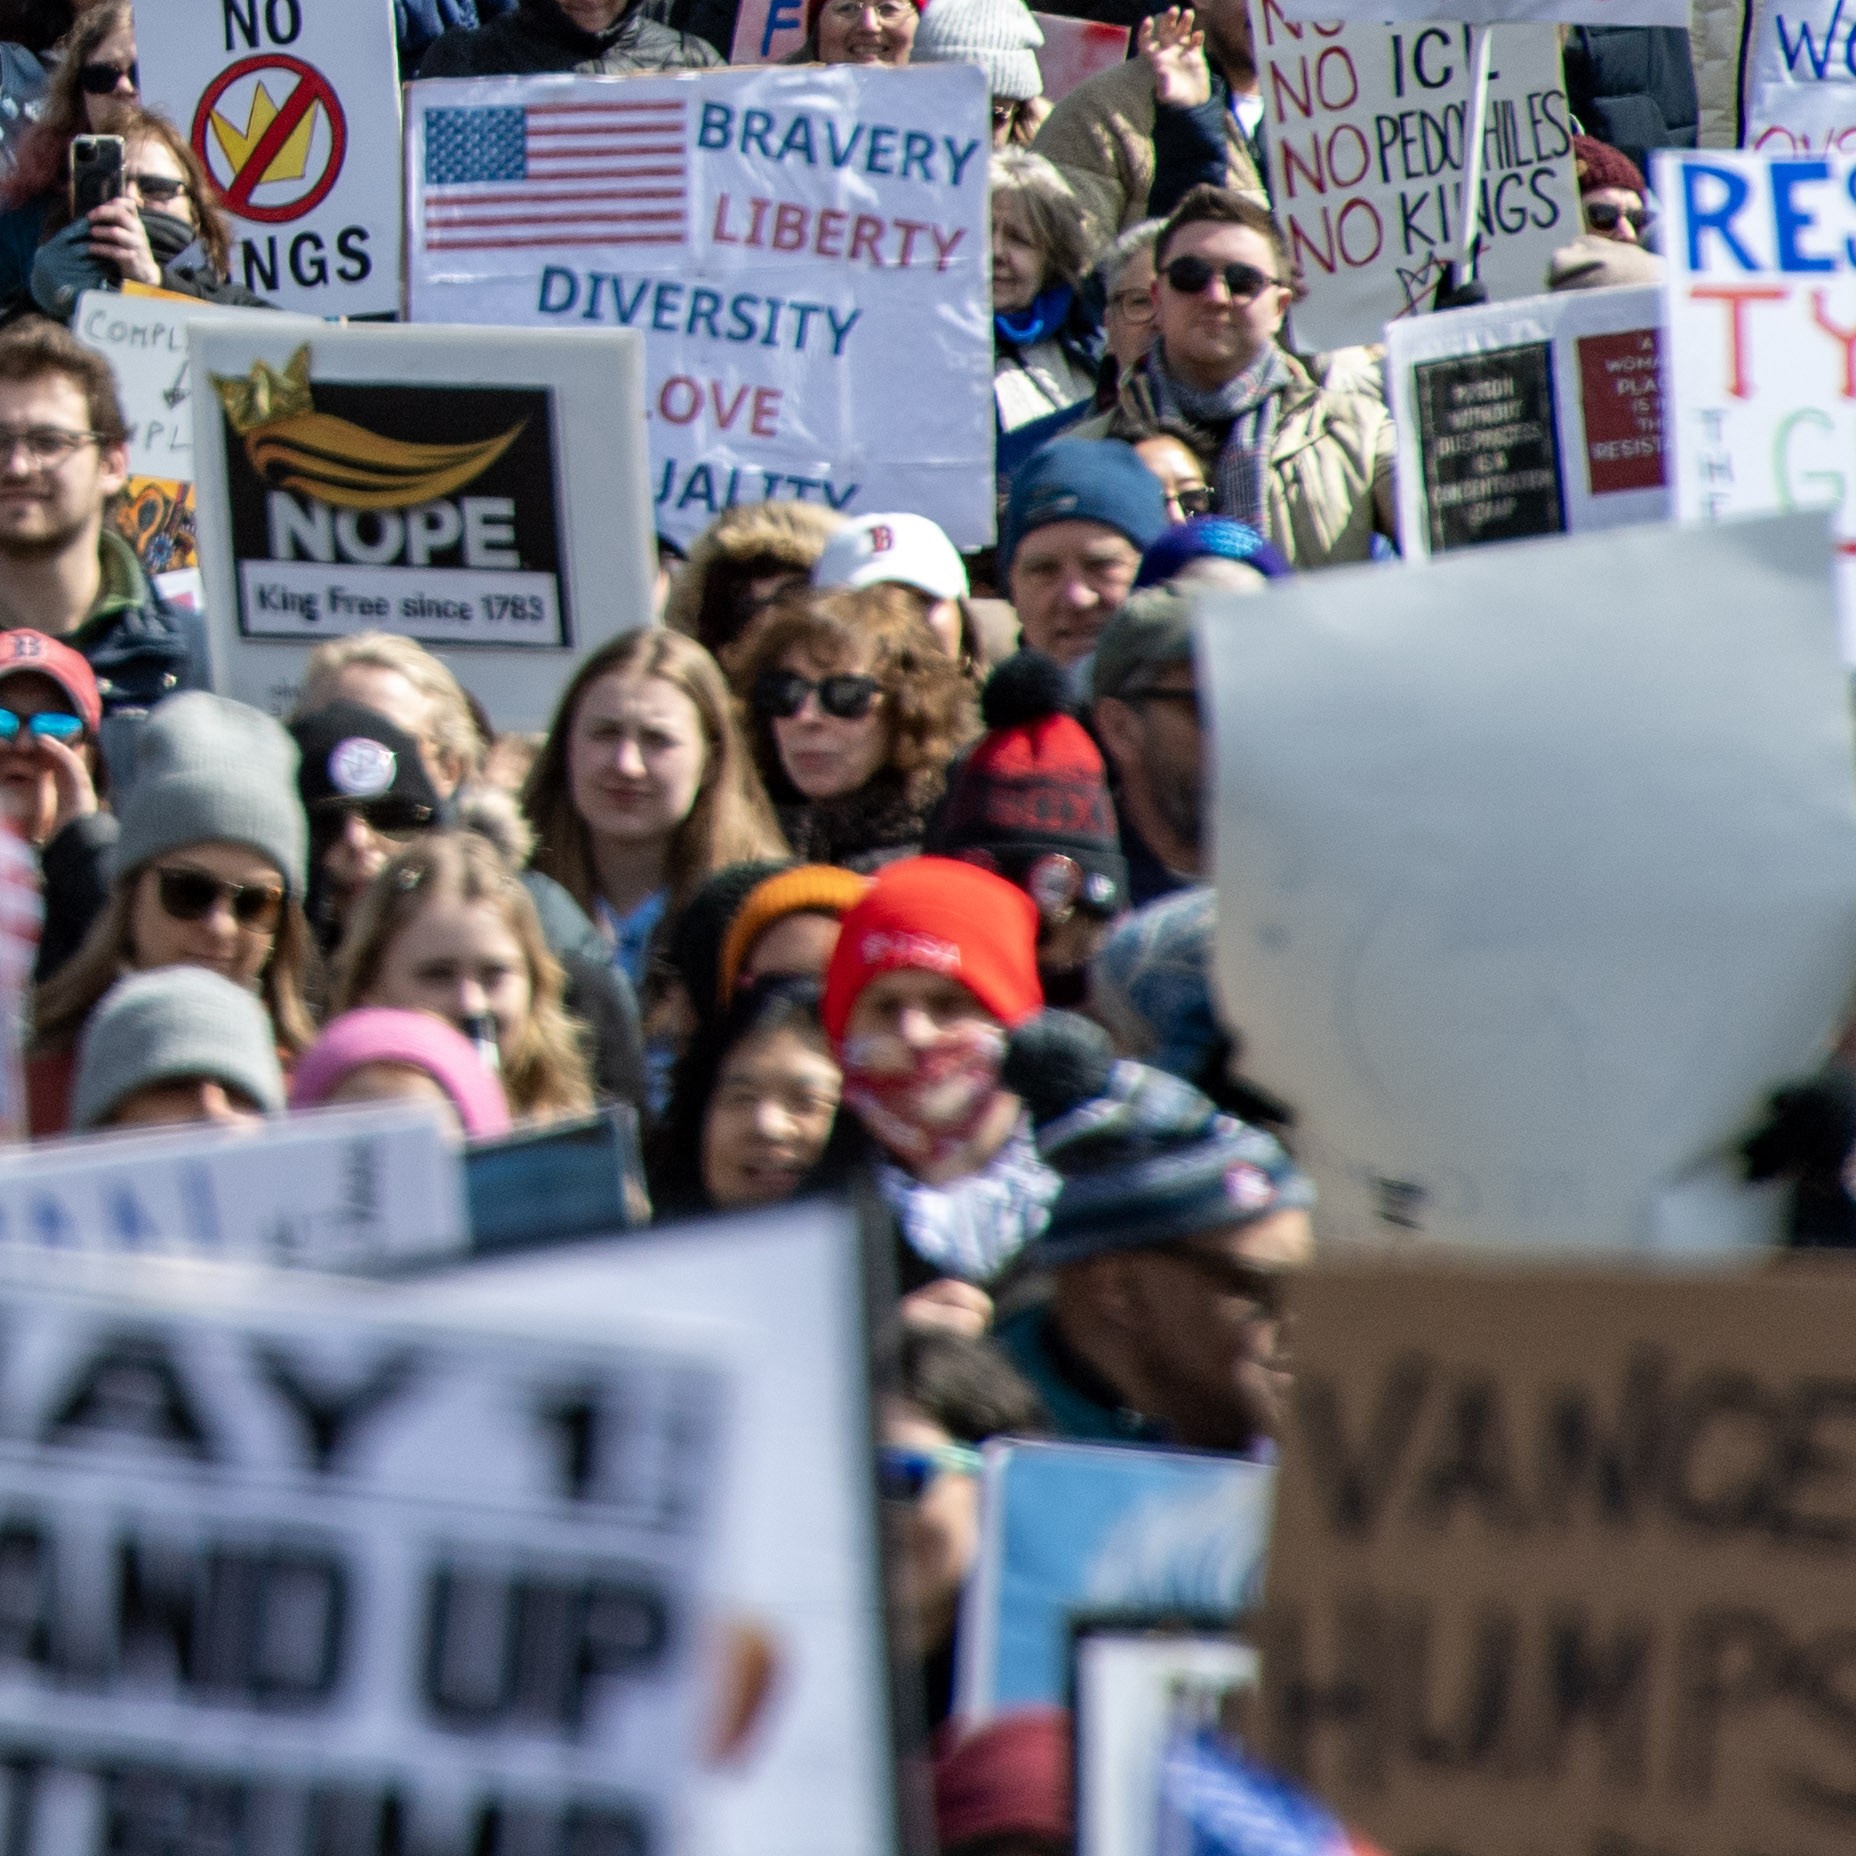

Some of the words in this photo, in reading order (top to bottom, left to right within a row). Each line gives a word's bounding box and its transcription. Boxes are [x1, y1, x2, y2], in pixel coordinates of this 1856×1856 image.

[1269, 46, 1358, 125] NO
[696, 102, 982, 187] BRAVERY
[1285, 123, 1371, 198] NO
[712, 193, 967, 273] LIBERTY
[1288, 198, 1383, 276] NO
[537, 263, 863, 358] DIVERSITY
[264, 488, 523, 571] NOPE
[255, 583, 319, 622] King
[326, 585, 388, 618] Free
[400, 592, 474, 621] since
[480, 593, 546, 623] 1783
[425, 1579, 670, 1766] UP
